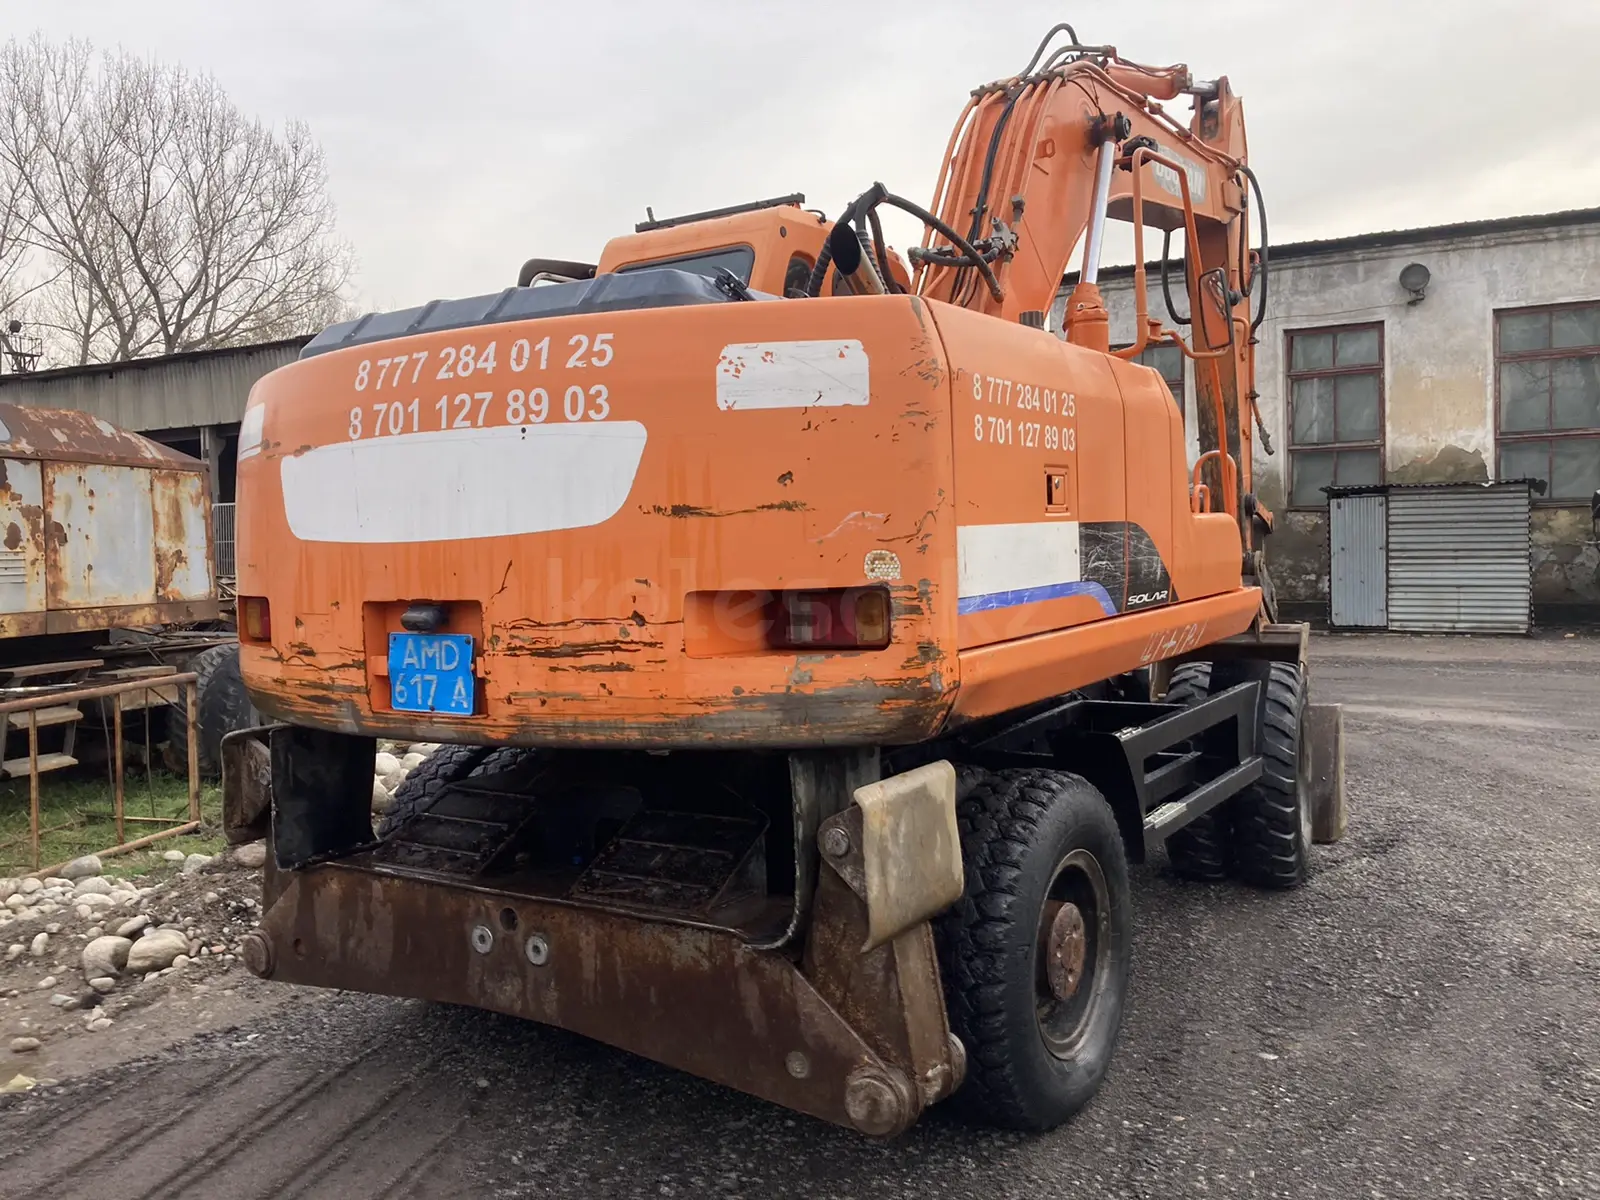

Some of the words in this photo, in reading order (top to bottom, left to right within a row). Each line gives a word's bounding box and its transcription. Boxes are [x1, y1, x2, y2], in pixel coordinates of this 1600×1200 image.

[354, 359, 370, 392] 8
[376, 351, 429, 390] 777
[436, 341, 497, 380] 284
[510, 337, 550, 373] 01
[566, 333, 614, 369] 25
[348, 406, 363, 440] 8
[372, 398, 420, 437] 701
[435, 391, 493, 430] 127
[505, 387, 550, 425] 89
[563, 384, 611, 422] 03
[973, 372, 983, 401] 8
[986, 375, 1012, 406] 777
[1016, 383, 1041, 411] 284
[1043, 389, 1057, 415] 01
[1061, 391, 1075, 418] 25
[974, 414, 984, 442] 8
[987, 416, 1013, 446] 701
[1018, 421, 1041, 449] 127
[1044, 424, 1059, 450] 89
[1062, 427, 1075, 452] 03
[1127, 590, 1168, 606] SOLAR
[402, 638, 460, 671] AMD
[395, 673, 438, 706] 617
[450, 676, 469, 708] A
